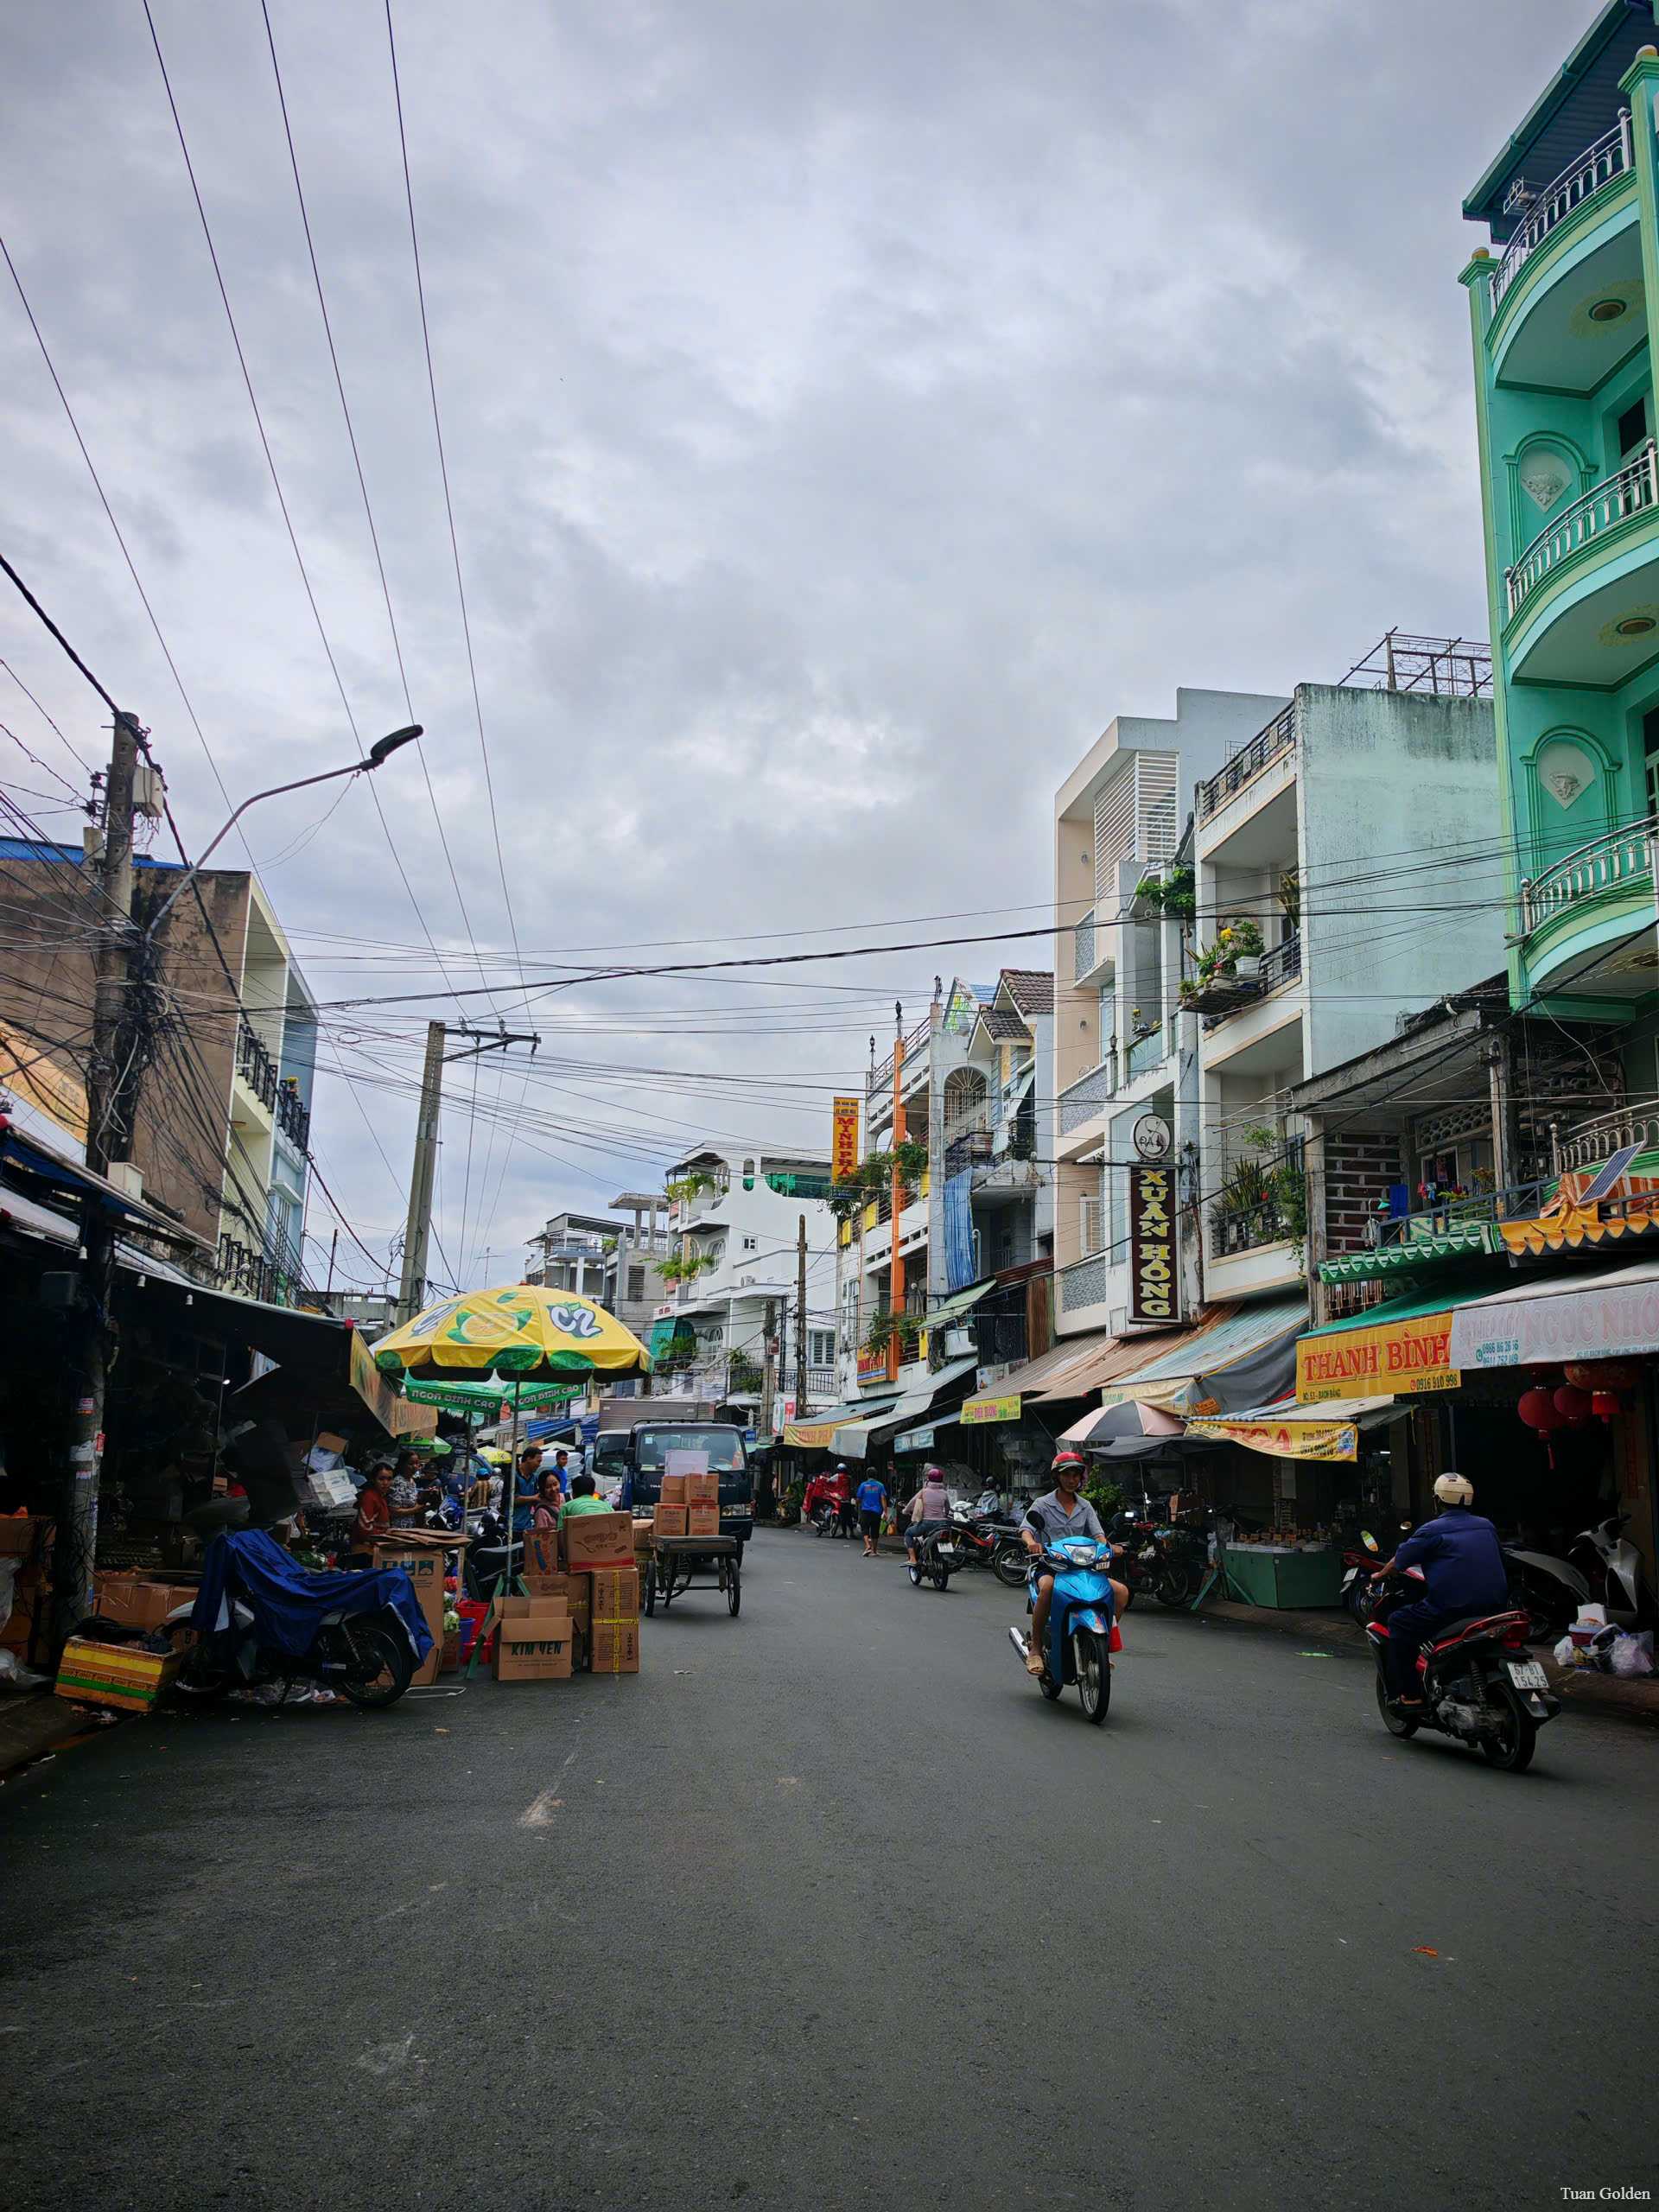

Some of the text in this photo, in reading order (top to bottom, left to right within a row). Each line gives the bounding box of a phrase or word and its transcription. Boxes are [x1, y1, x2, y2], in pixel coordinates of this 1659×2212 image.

[836, 1116, 855, 1149] MINH
[549, 1303, 603, 1338] C2
[1303, 1344, 1380, 1382] THANH
[1387, 1329, 1451, 1373] BÌNH
